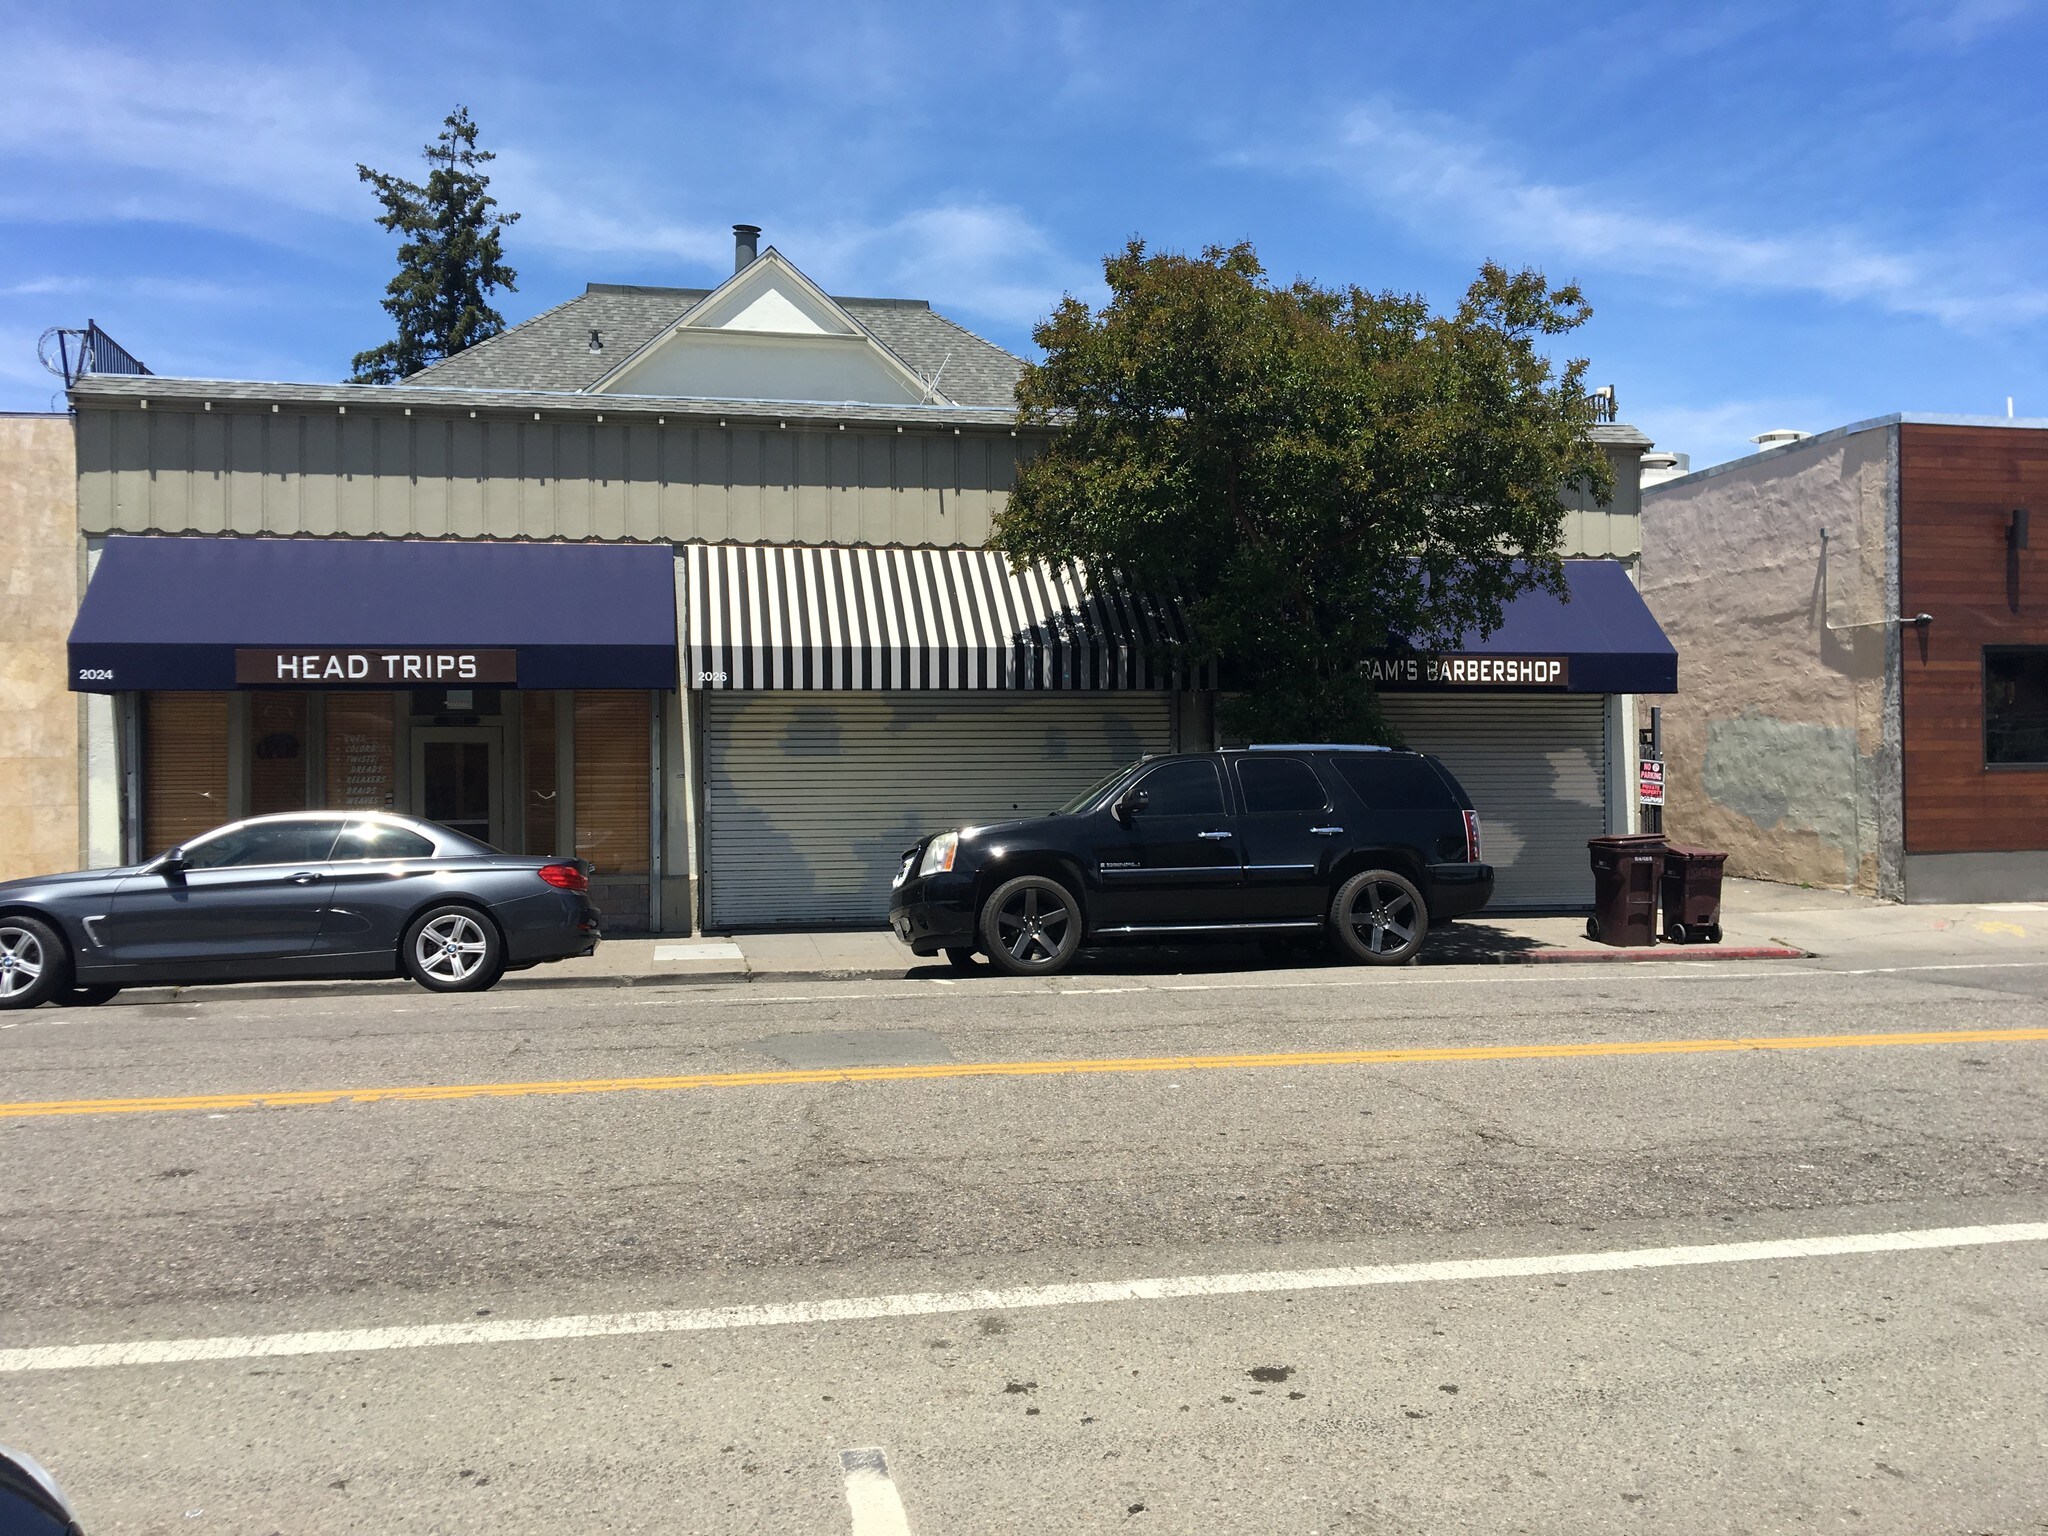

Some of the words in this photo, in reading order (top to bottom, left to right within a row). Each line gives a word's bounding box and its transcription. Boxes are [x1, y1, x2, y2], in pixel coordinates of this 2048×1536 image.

[277, 654, 369, 680] HEAD
[382, 654, 478, 679] TRIPS
[1359, 659, 1418, 681] RAM'S
[1427, 660, 1561, 682] BARBERSHOP
[79, 669, 114, 680] 2024
[698, 671, 728, 682] 2026
[345, 744, 376, 753] COLORS
[351, 765, 383, 774] DREADS
[1643, 763, 1651, 771] NO
[346, 775, 387, 784] RELAXERS
[1640, 771, 1662, 780] PARKING
[346, 786, 377, 795] BRAIDS
[346, 796, 379, 805] WEAVES
